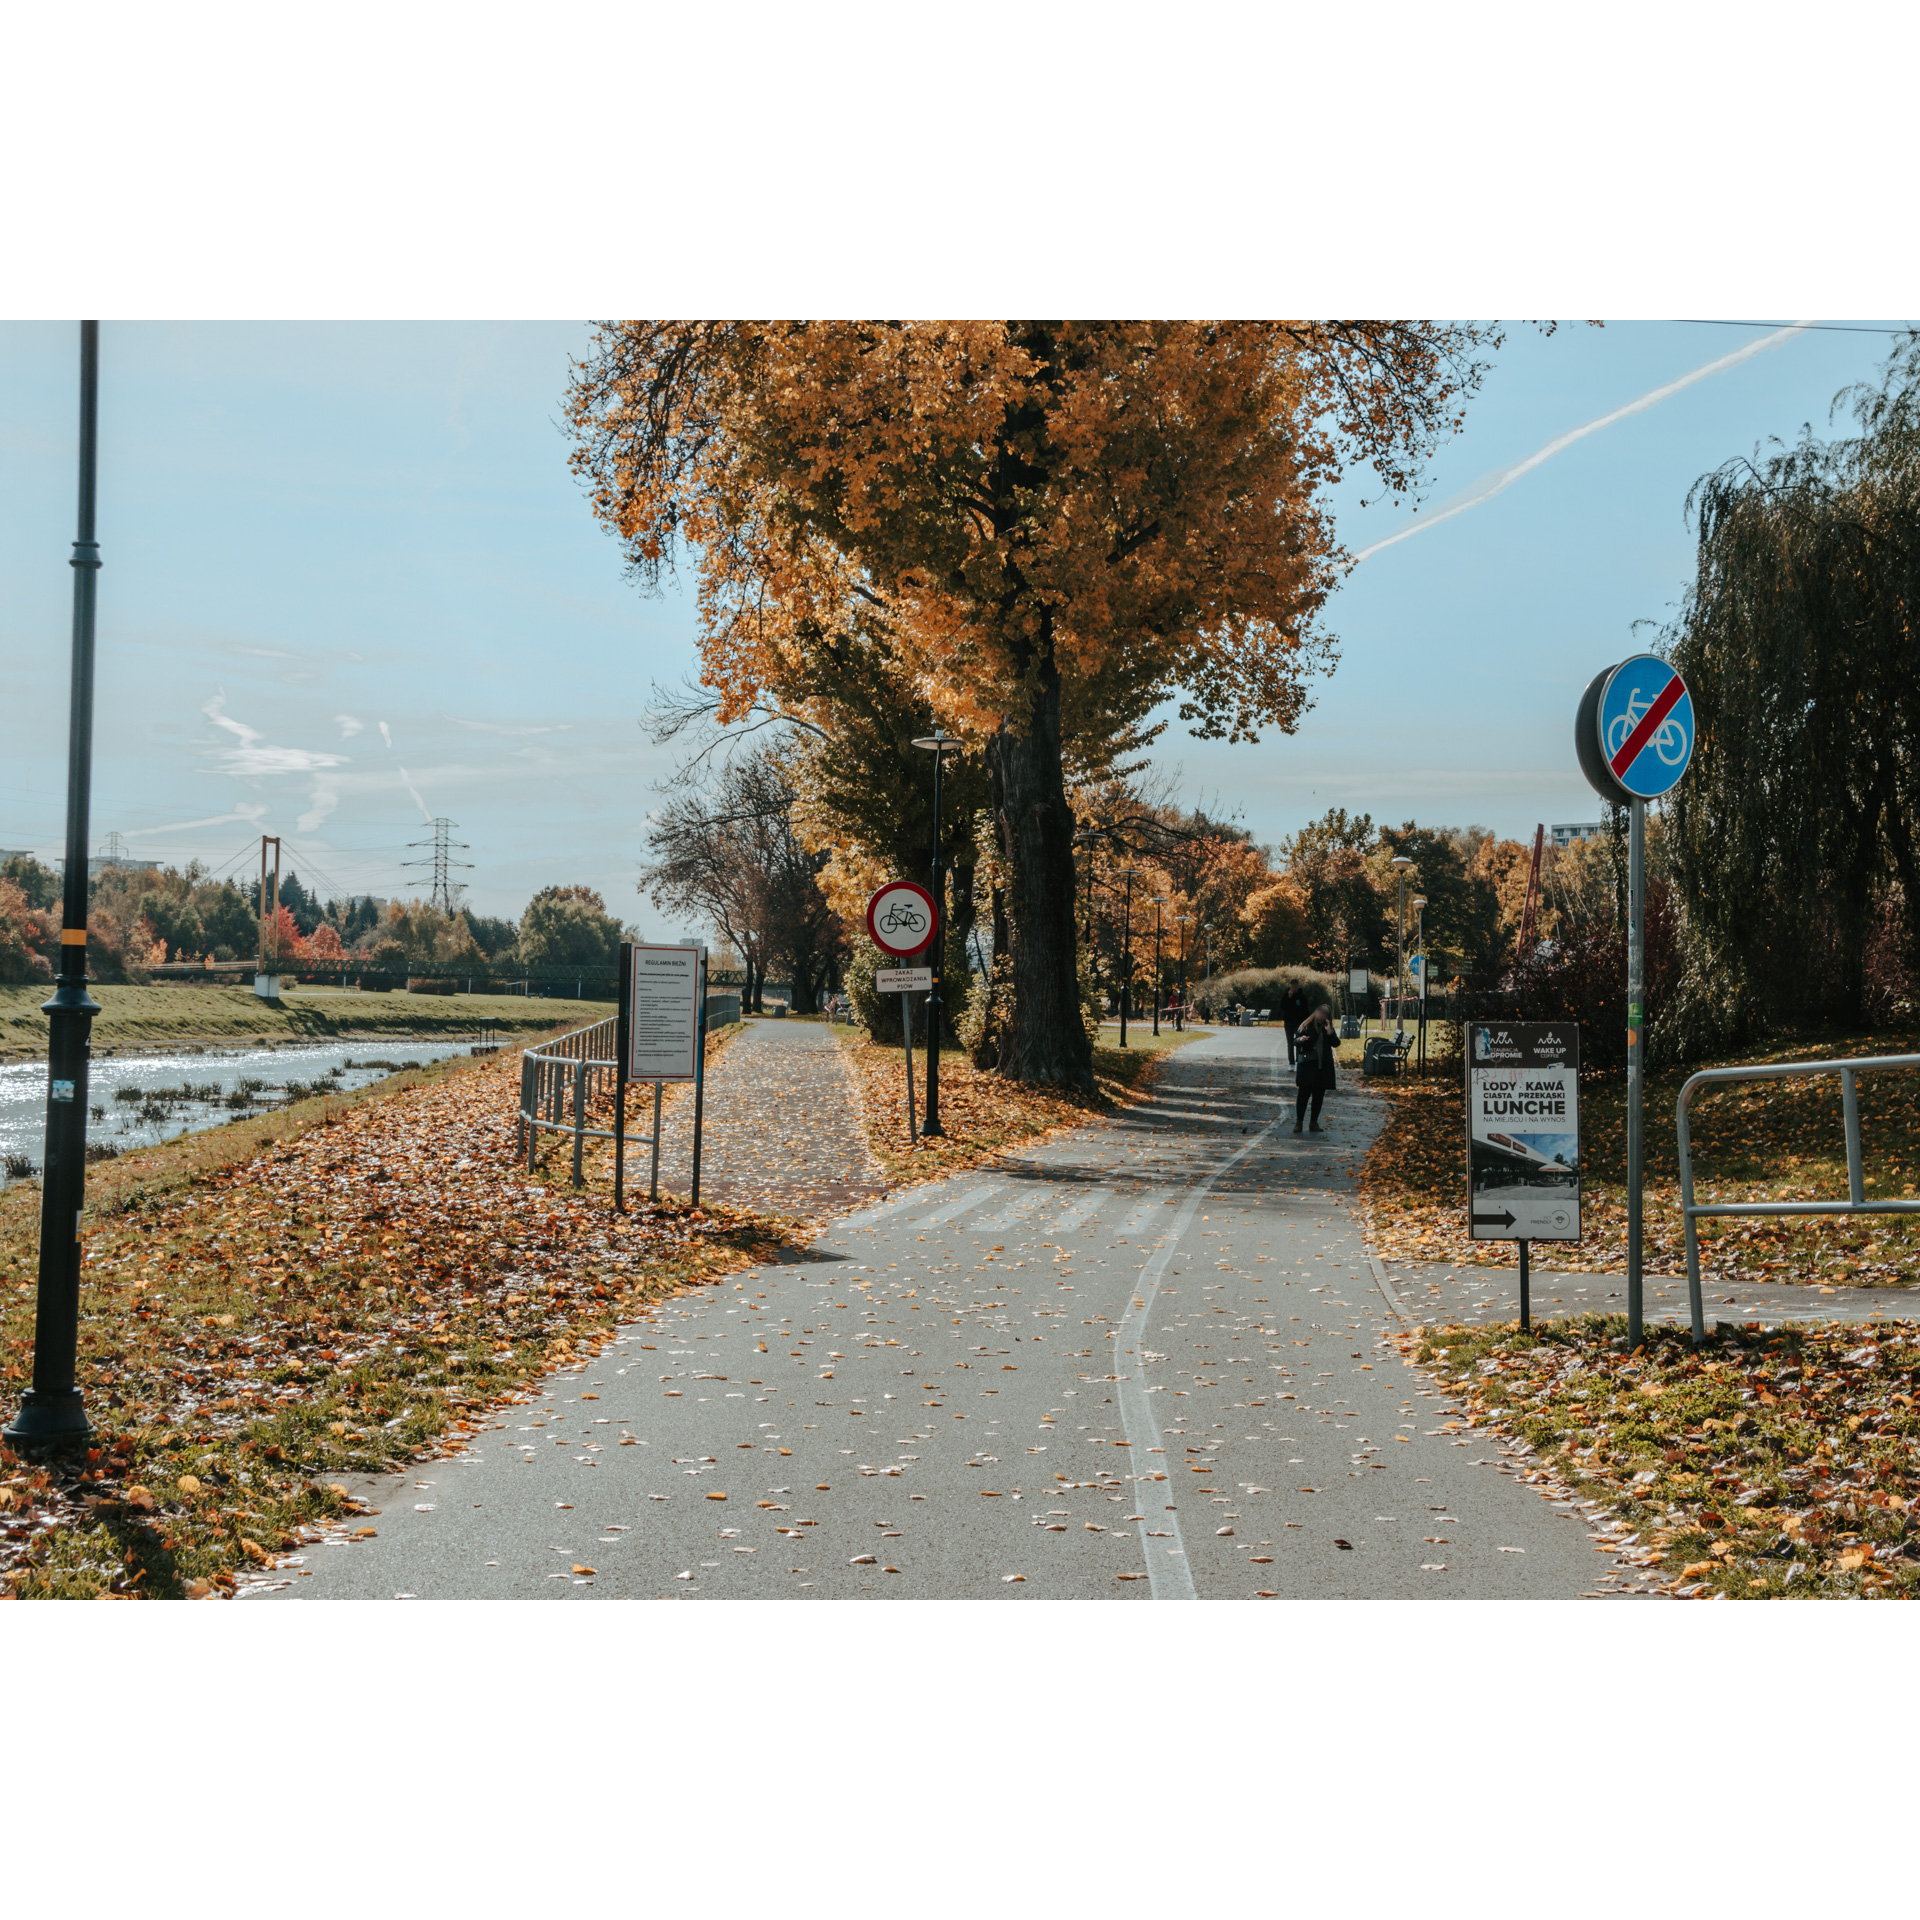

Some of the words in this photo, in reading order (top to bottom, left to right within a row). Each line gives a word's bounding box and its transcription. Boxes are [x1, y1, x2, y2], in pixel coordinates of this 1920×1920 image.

[1483, 1082, 1516, 1091] LODY
[1526, 1082, 1564, 1091] KAWA
[1518, 1092, 1565, 1100] PRZEKĄSKI
[1483, 1100, 1565, 1114] LUNCHE
